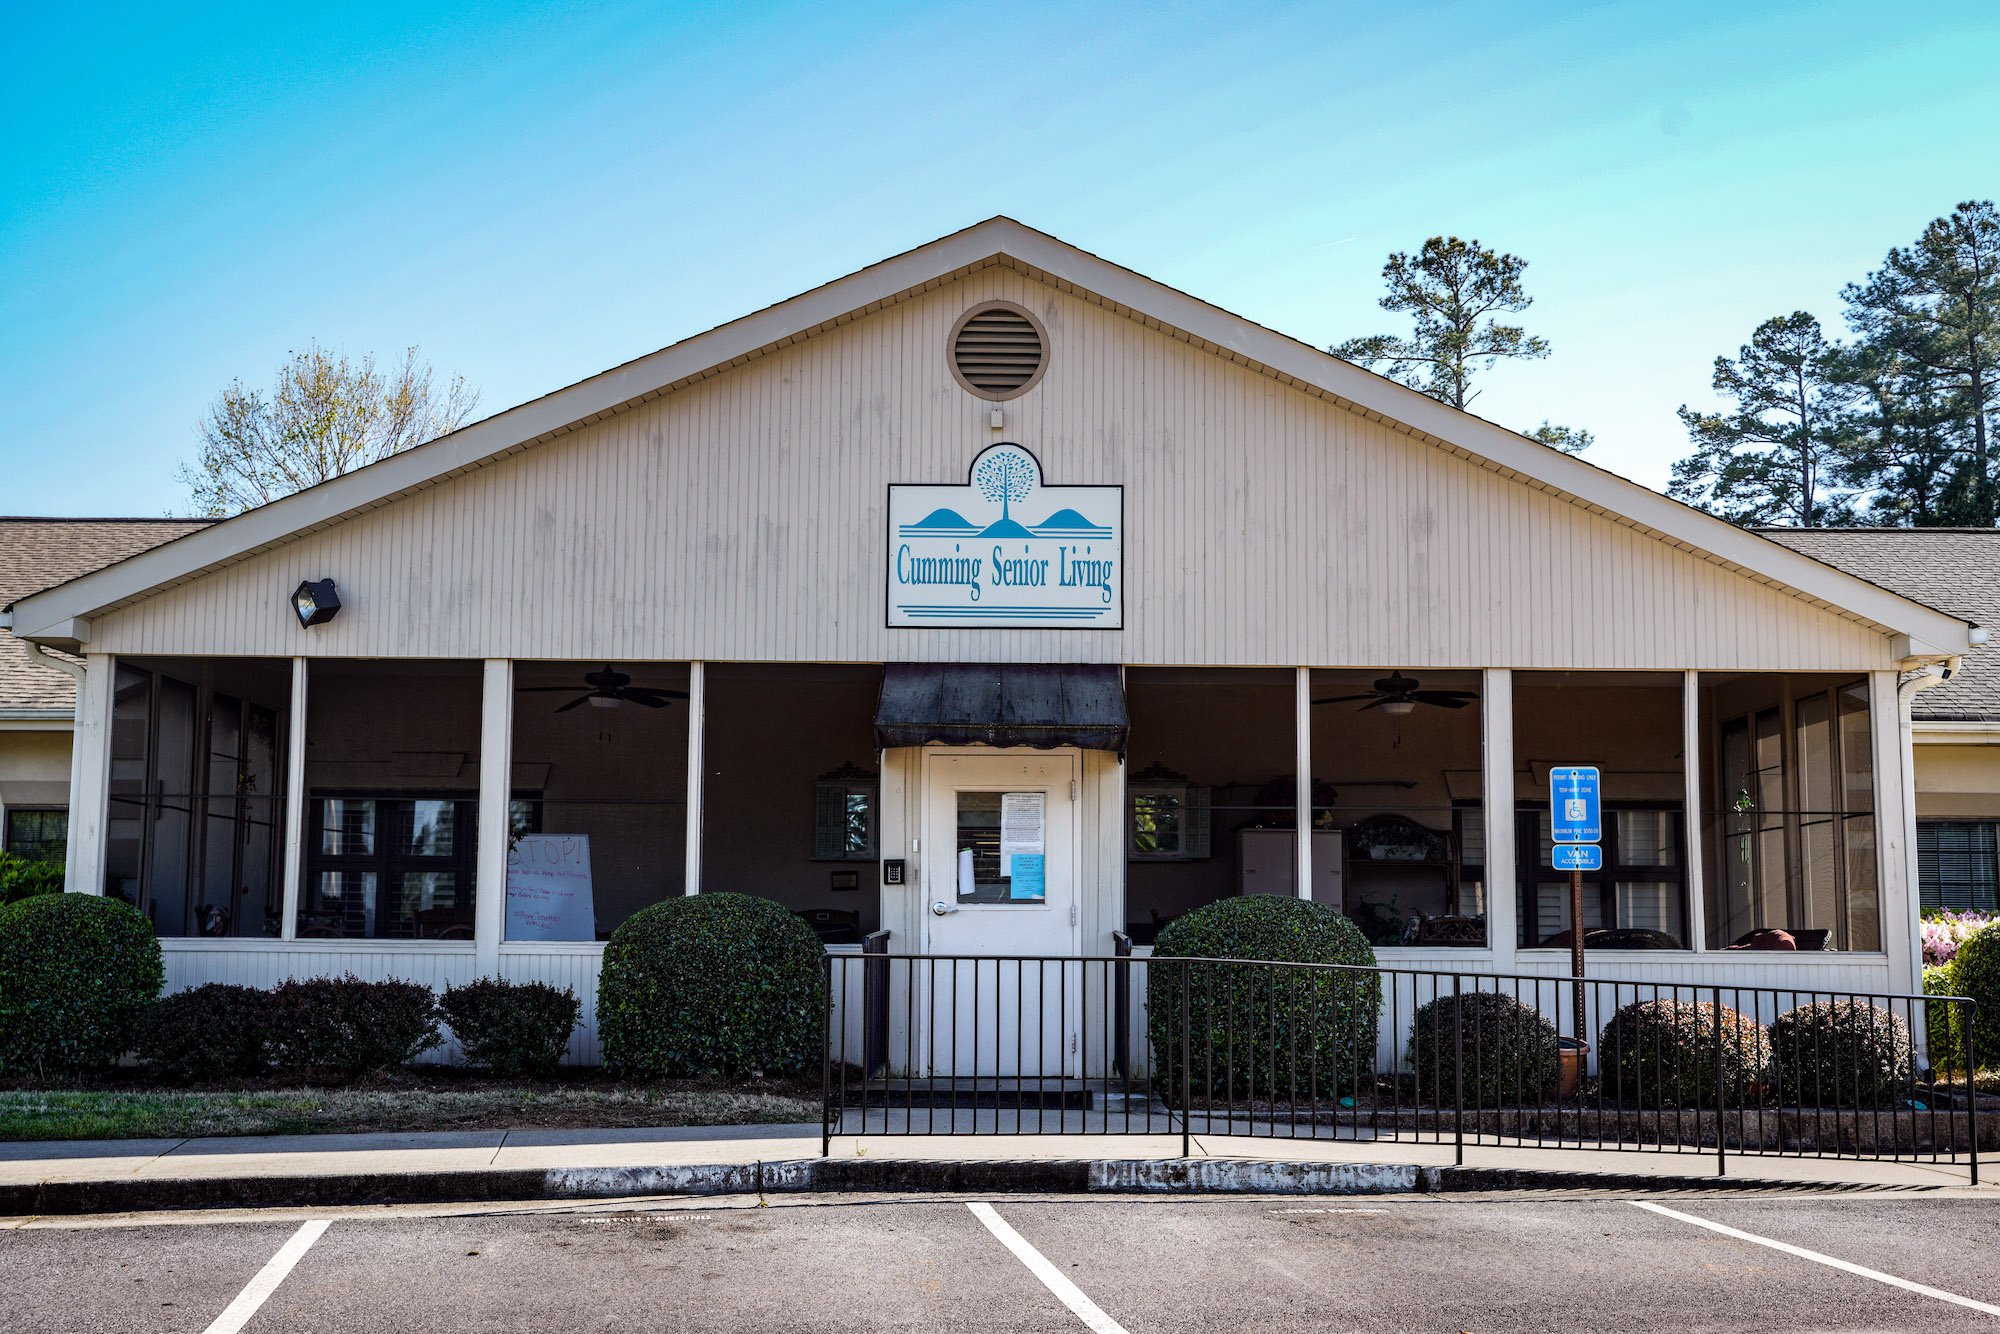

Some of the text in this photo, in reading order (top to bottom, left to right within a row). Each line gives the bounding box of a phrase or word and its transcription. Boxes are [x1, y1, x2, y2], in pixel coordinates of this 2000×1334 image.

[897, 543, 1113, 604] Cumming Senior Living
[1566, 850, 1589, 858] VAN
